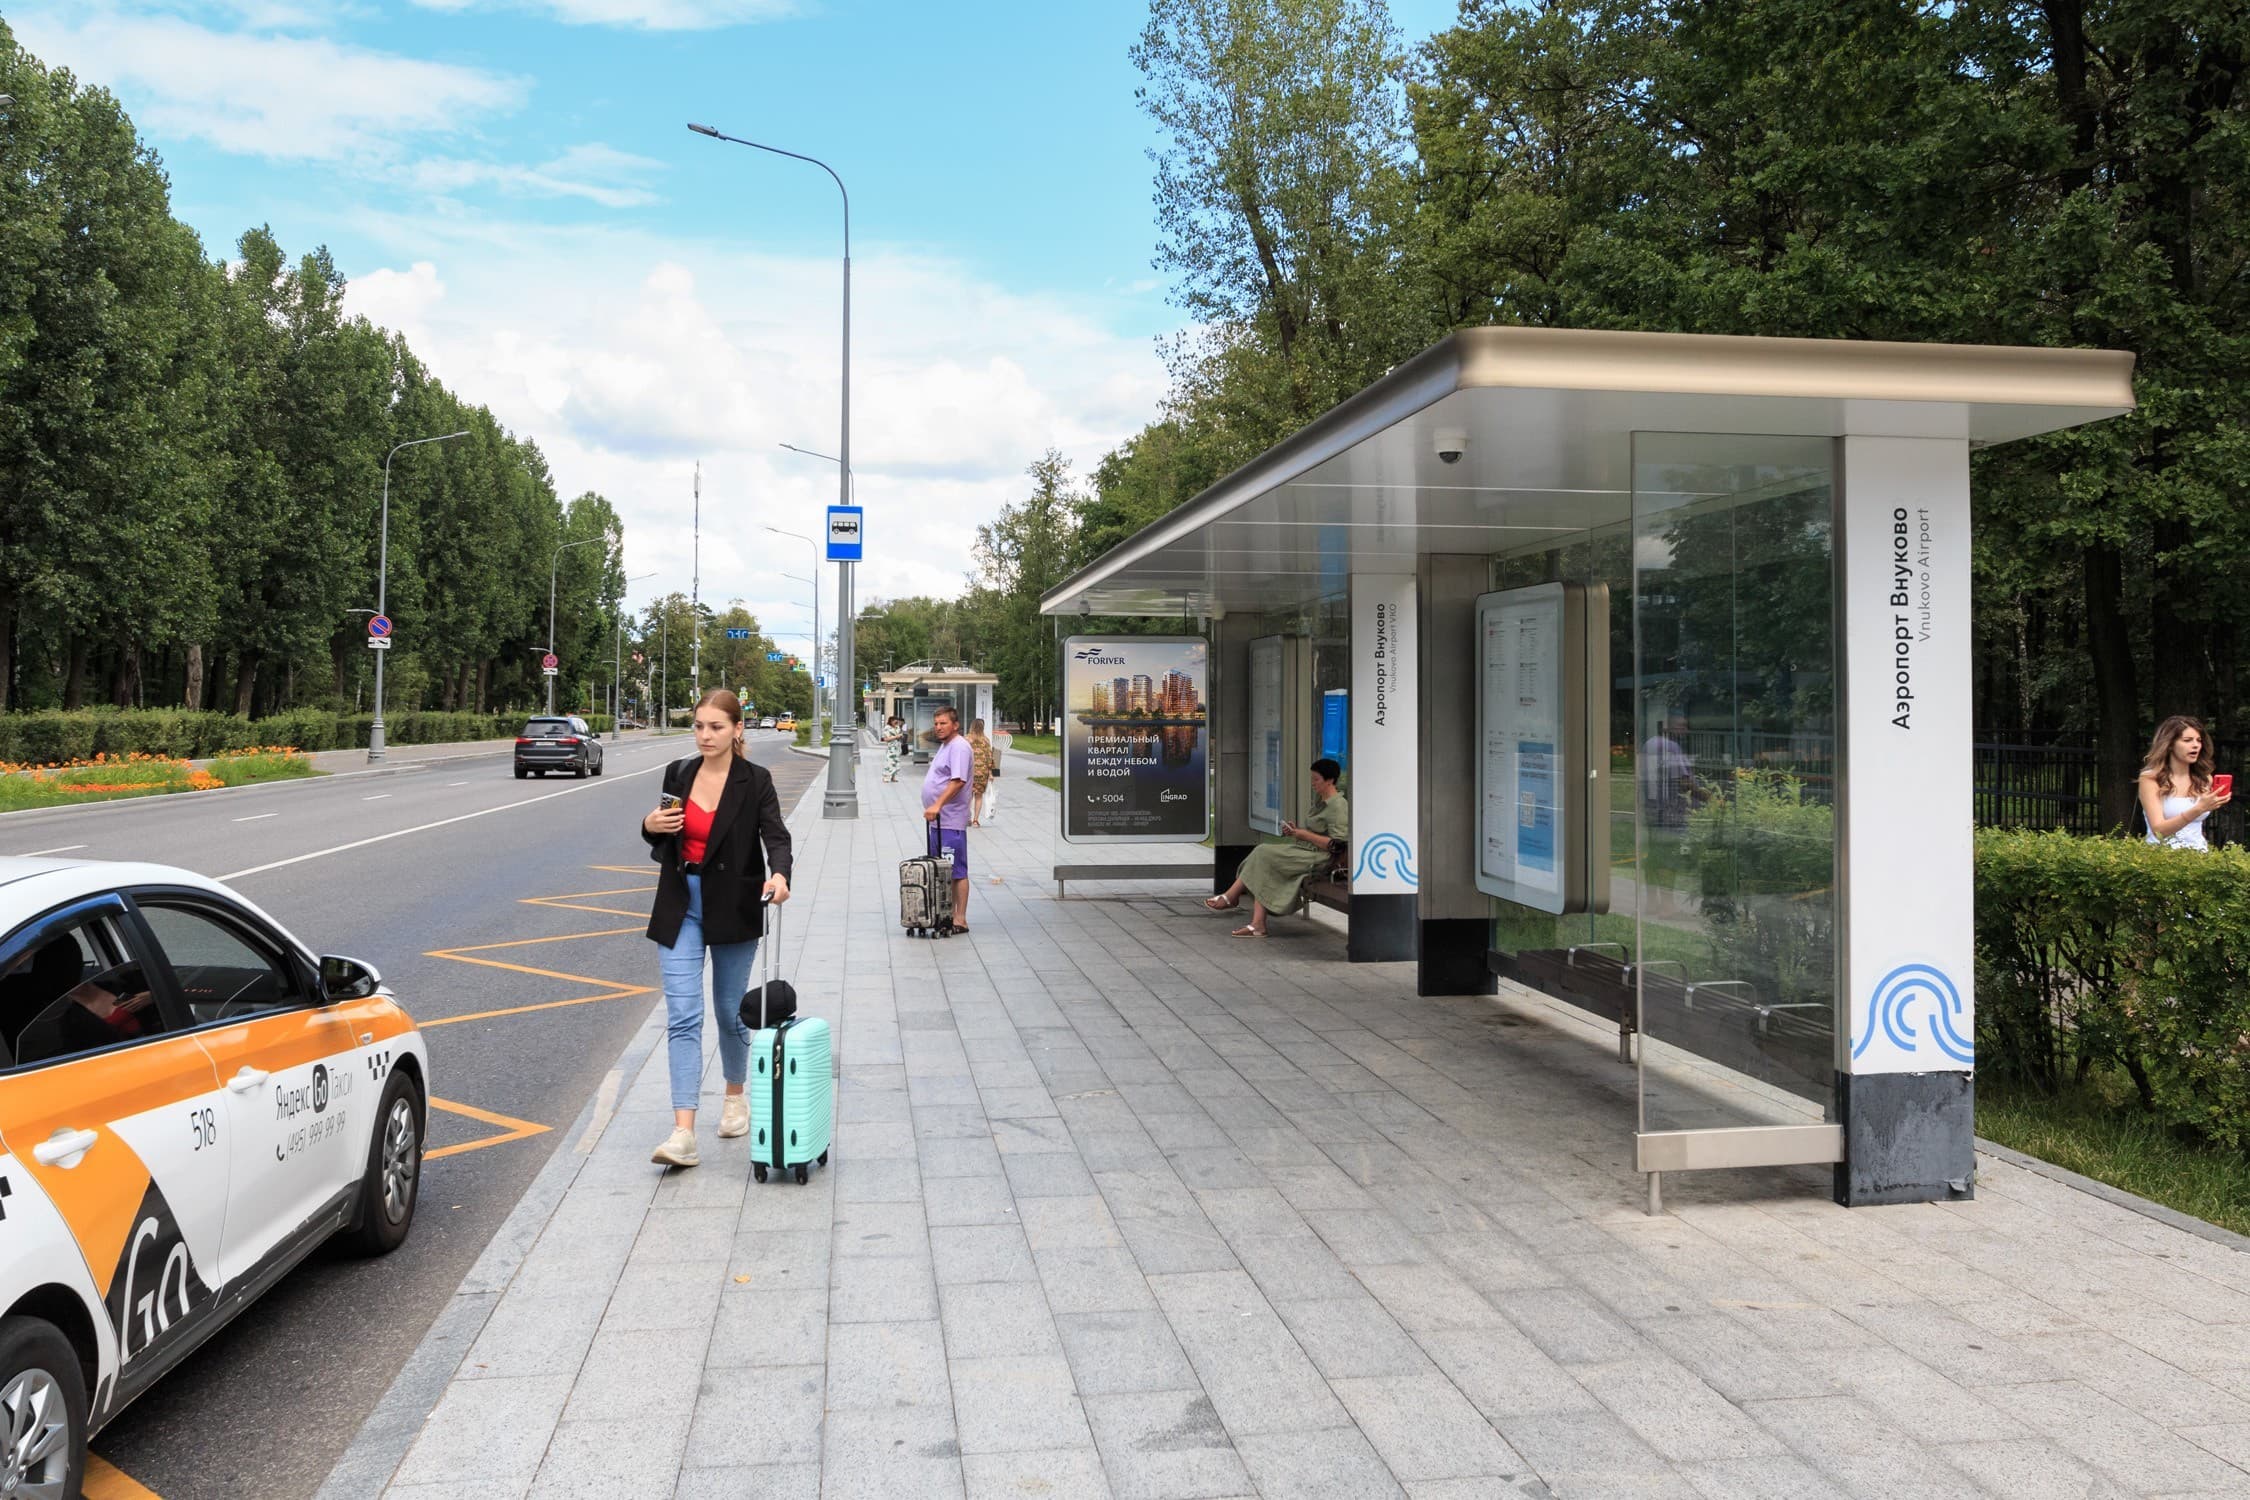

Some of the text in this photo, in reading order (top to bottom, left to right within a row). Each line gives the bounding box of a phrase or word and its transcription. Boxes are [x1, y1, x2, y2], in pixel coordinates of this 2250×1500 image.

[1917, 508, 1933, 642] Vnukovo Airport
[1890, 507, 1914, 730] Аэропорт Внуково
[1088, 657, 1126, 665] FORIVER
[1375, 603, 1388, 727] Аэропорт Внуково
[1389, 603, 1398, 693] Vnukovo Airport VKO
[1087, 734, 1160, 744] ПРЕМИАЛЬНЫЙ
[1087, 747, 1129, 755] КВАРТАЛ
[1087, 758, 1122, 766] МЕЖДУ
[1087, 767, 1131, 778] И ВОДОЙ
[276, 1067, 353, 1120] Яндекс Go Такси
[191, 1108, 216, 1151] 518
[286, 1110, 346, 1160] (495) 999 99 99
